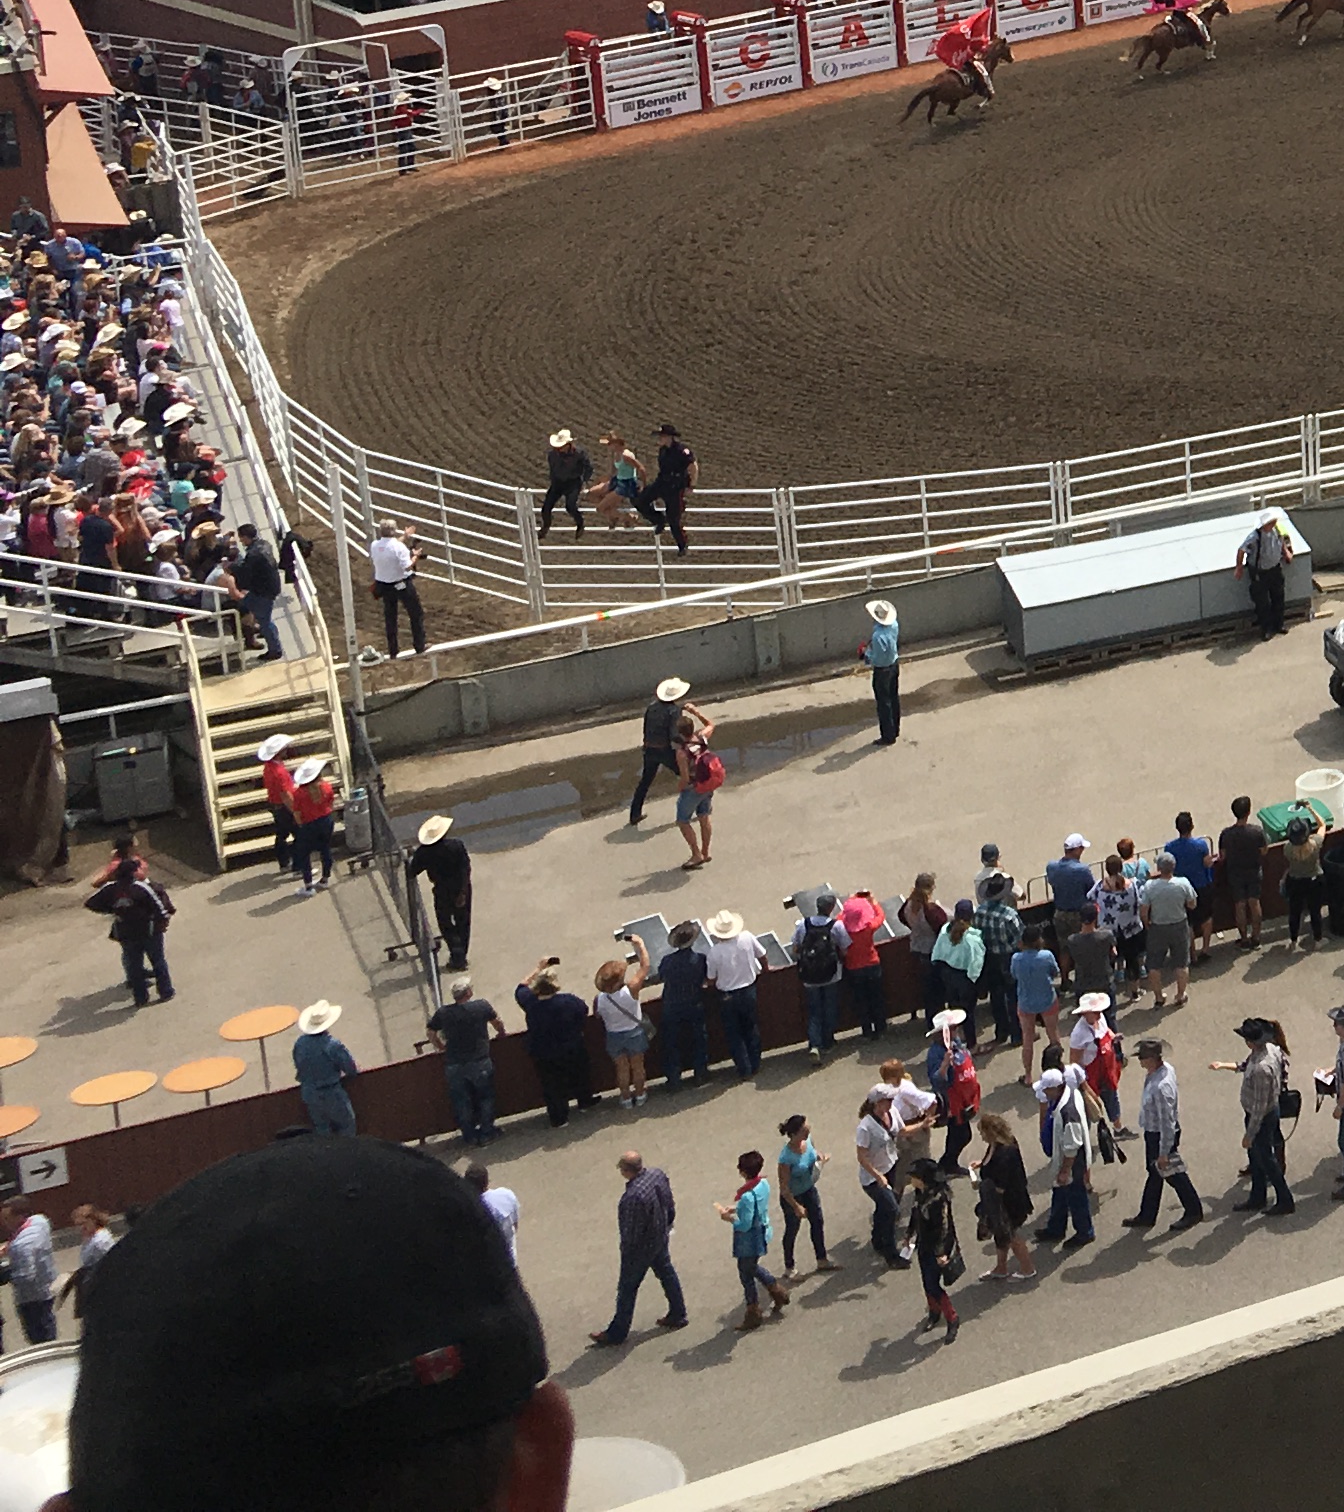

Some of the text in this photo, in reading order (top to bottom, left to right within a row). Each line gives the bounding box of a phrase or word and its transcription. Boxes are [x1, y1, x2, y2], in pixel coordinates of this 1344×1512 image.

[739, 33, 770, 70] C
[840, 14, 869, 50] A
[841, 55, 890, 72] TransCanada
[750, 75, 794, 91] REPSOL
[637, 91, 688, 109] Bennett
[634, 107, 673, 121] Jones
